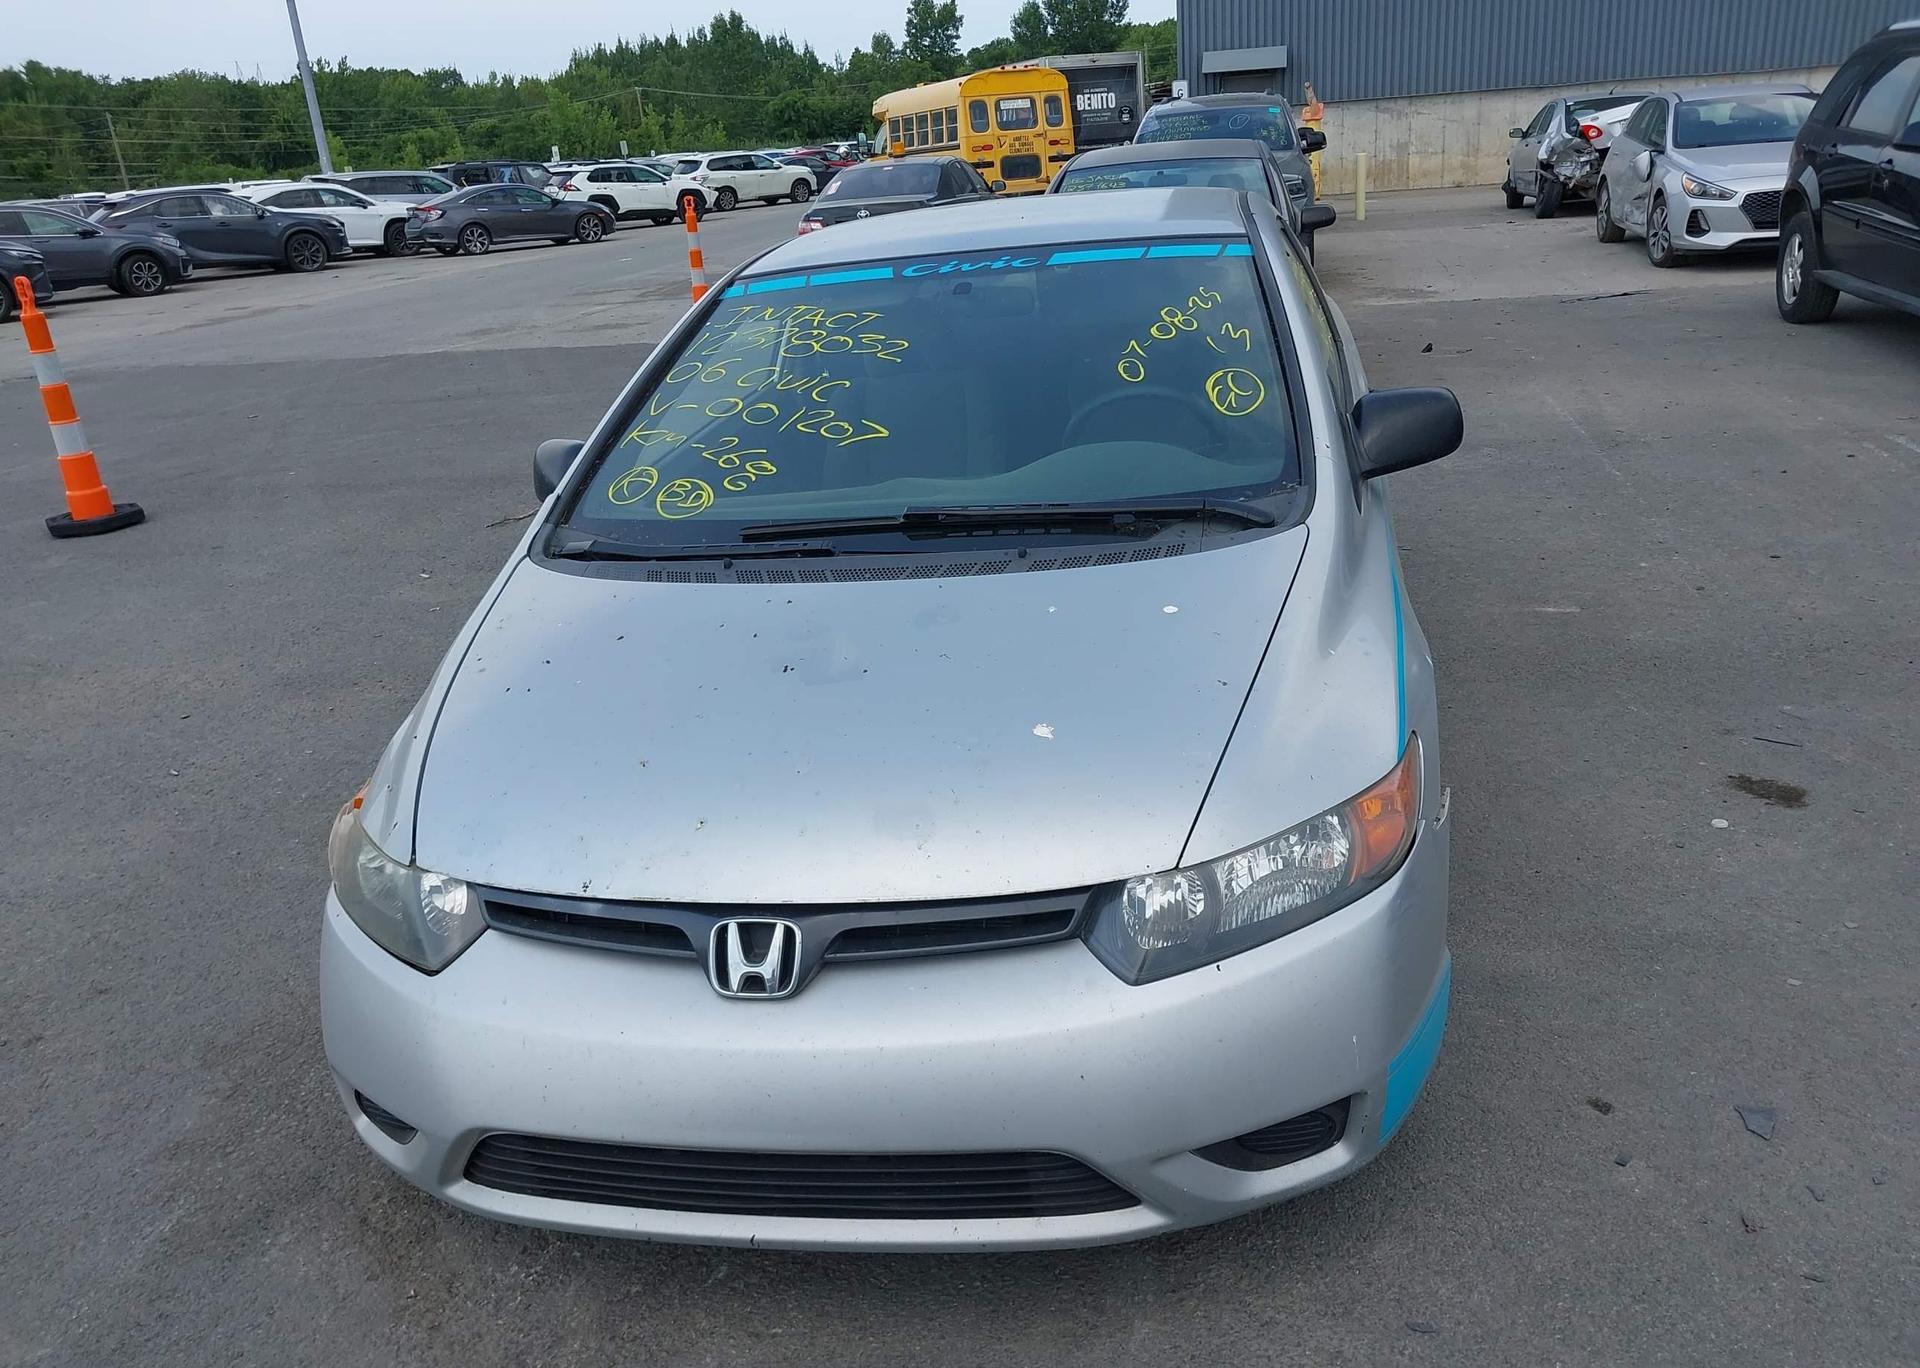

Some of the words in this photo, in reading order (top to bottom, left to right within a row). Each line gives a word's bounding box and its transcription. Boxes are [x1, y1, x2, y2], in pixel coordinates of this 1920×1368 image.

[1076, 92, 1116, 111] BENITO
[1177, 88, 1184, 99] G
[902, 256, 1041, 277] Civic
[714, 305, 885, 333] INTACT
[667, 358, 742, 383] 06
